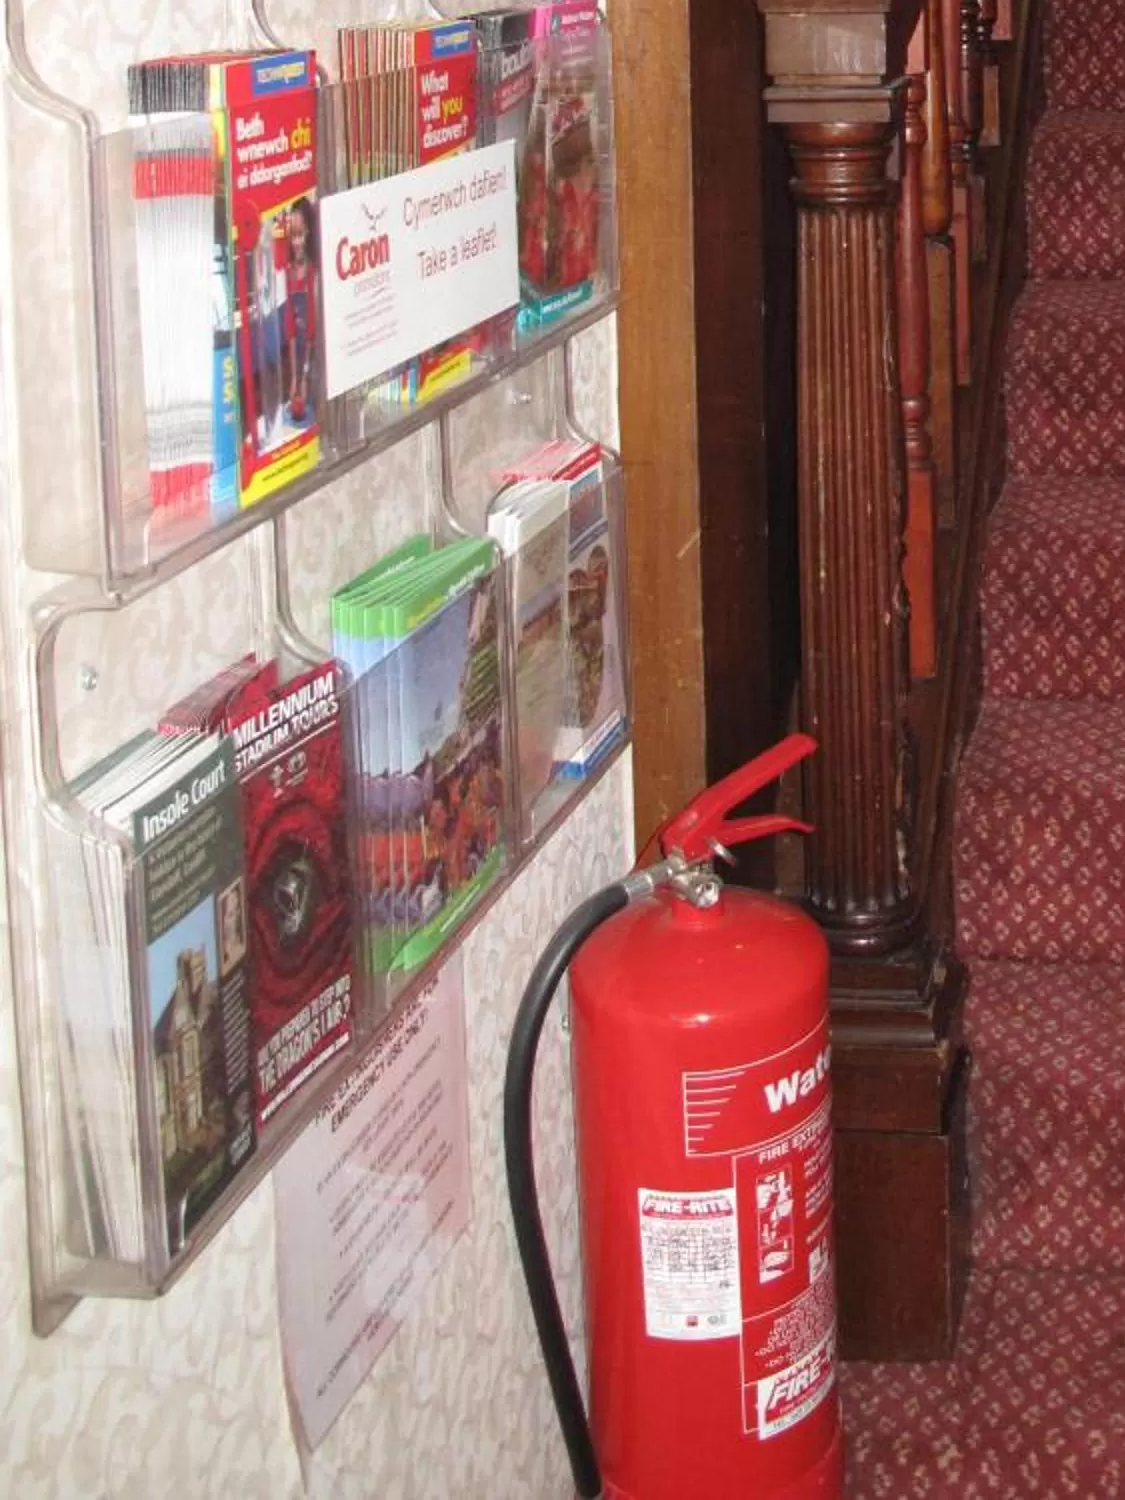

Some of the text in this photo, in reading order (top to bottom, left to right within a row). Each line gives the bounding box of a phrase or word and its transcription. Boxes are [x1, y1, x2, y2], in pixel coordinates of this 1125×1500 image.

[420, 69, 450, 96] What
[236, 111, 264, 142] Beth
[420, 96, 463, 124] will you
[237, 116, 311, 164] wnewch chi
[422, 114, 469, 150] discover?
[335, 232, 392, 282] Caron
[416, 246, 448, 282] Take
[449, 244, 459, 268] a
[233, 671, 335, 750] MILLENNIUM
[234, 693, 340, 774] STADIUM TOURS
[143, 759, 226, 843] Insole Court
[758, 1140, 790, 1164] FIRE
